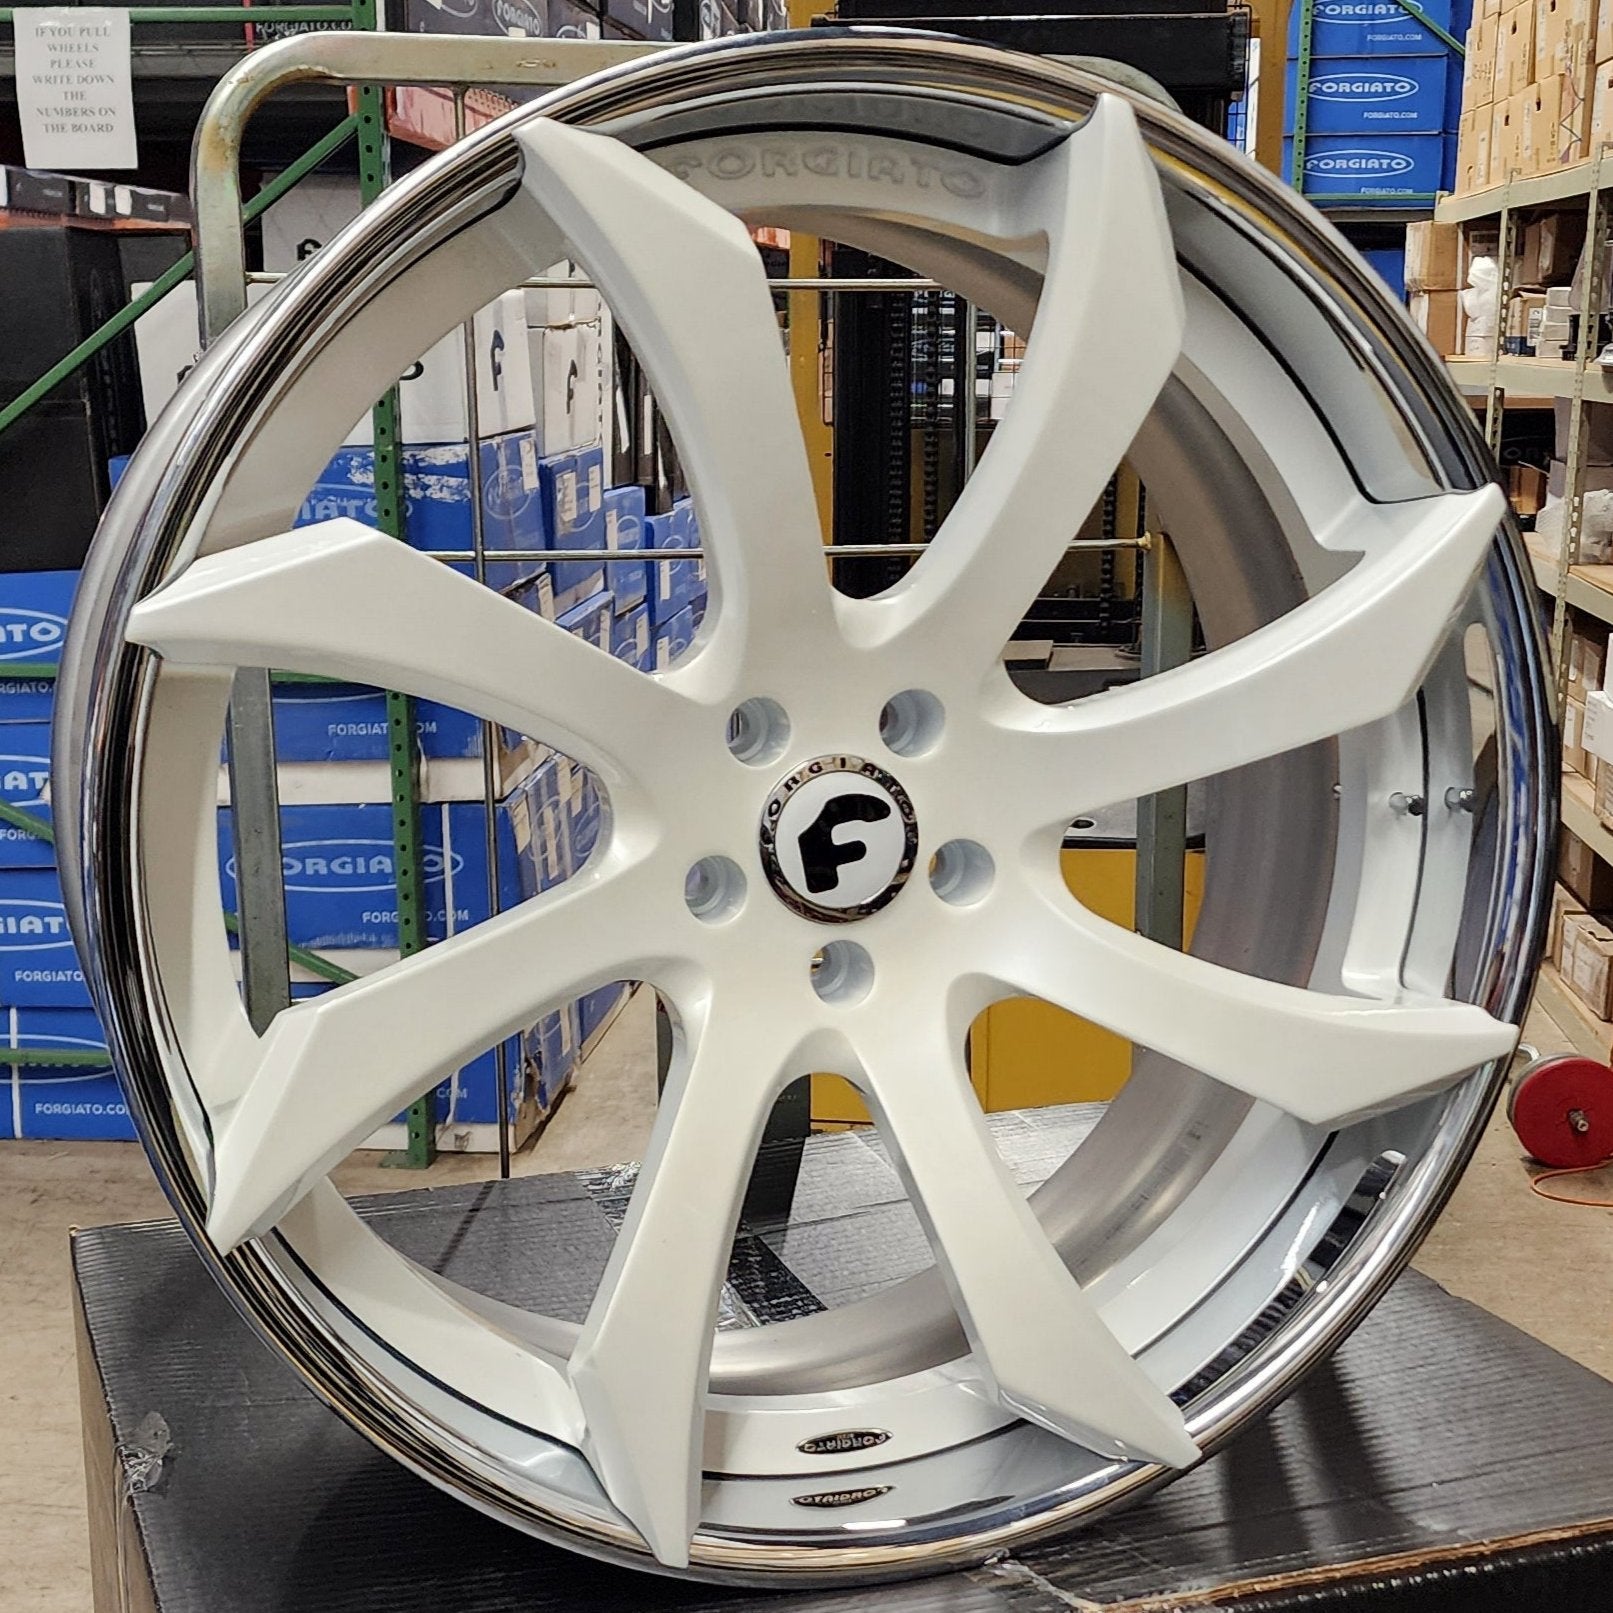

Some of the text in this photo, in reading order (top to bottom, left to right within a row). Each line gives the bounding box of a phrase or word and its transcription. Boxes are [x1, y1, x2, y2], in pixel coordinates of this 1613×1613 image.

[35, 26, 111, 37] IF YOU PULL
[1366, 33, 1422, 41] FORGIATO.COM
[47, 43, 99, 53] WHEELS
[50, 59, 95, 68] PLEASE
[32, 75, 115, 84] WRITE DOWN
[1309, 82, 1411, 92] FORGIATO
[63, 91, 87, 100] THE
[36, 107, 116, 117] NUMBERS ON
[44, 123, 114, 133] THE BOARD
[1306, 159, 1406, 169] FORGIATO
